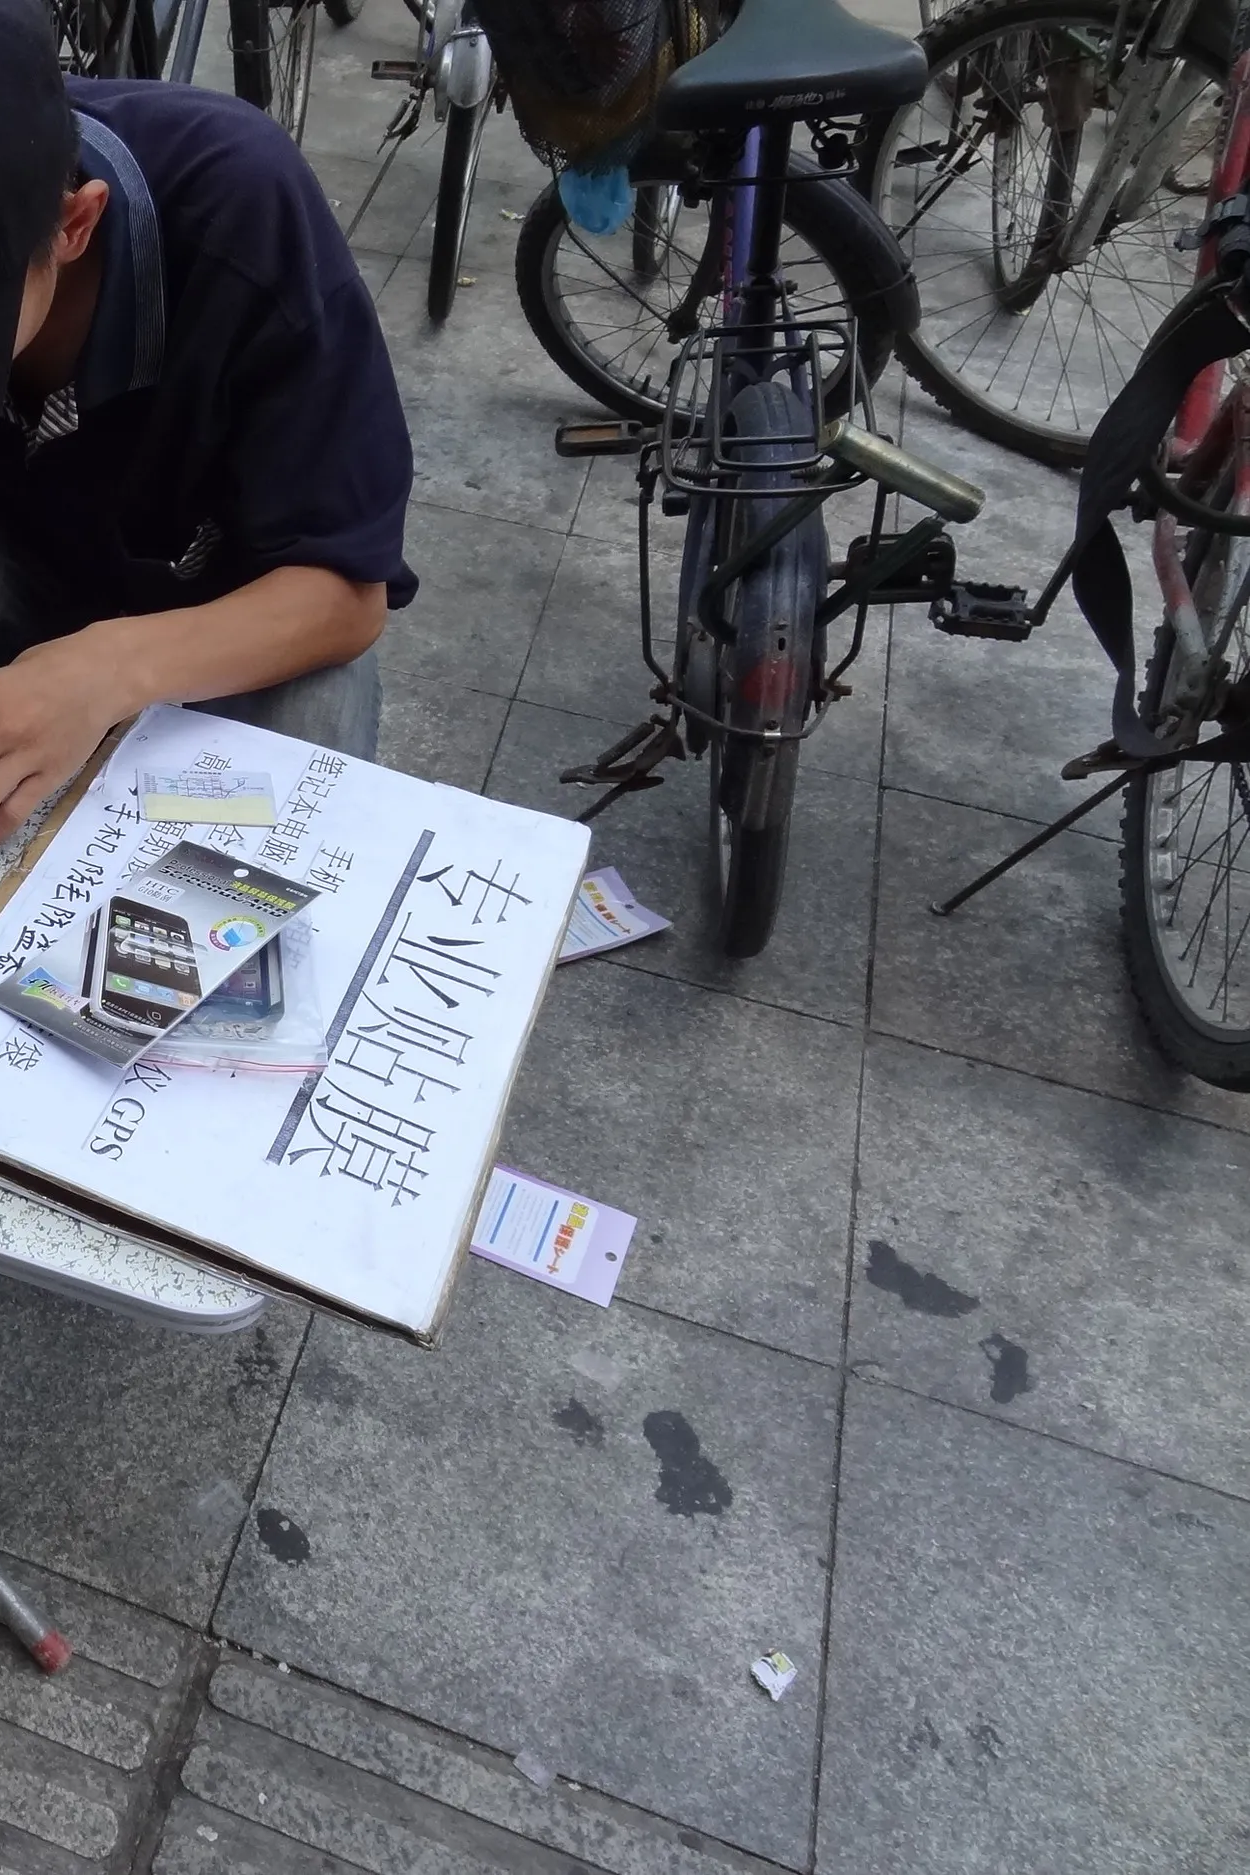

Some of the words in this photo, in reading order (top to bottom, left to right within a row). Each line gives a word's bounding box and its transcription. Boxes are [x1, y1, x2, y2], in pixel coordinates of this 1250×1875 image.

[258, 753, 348, 865] 笔记本电脑
[145, 880, 180, 896] HTC
[168, 858, 231, 886] Professional
[287, 857, 533, 1209] 专业贴膜
[90, 1097, 145, 1162] GPS
